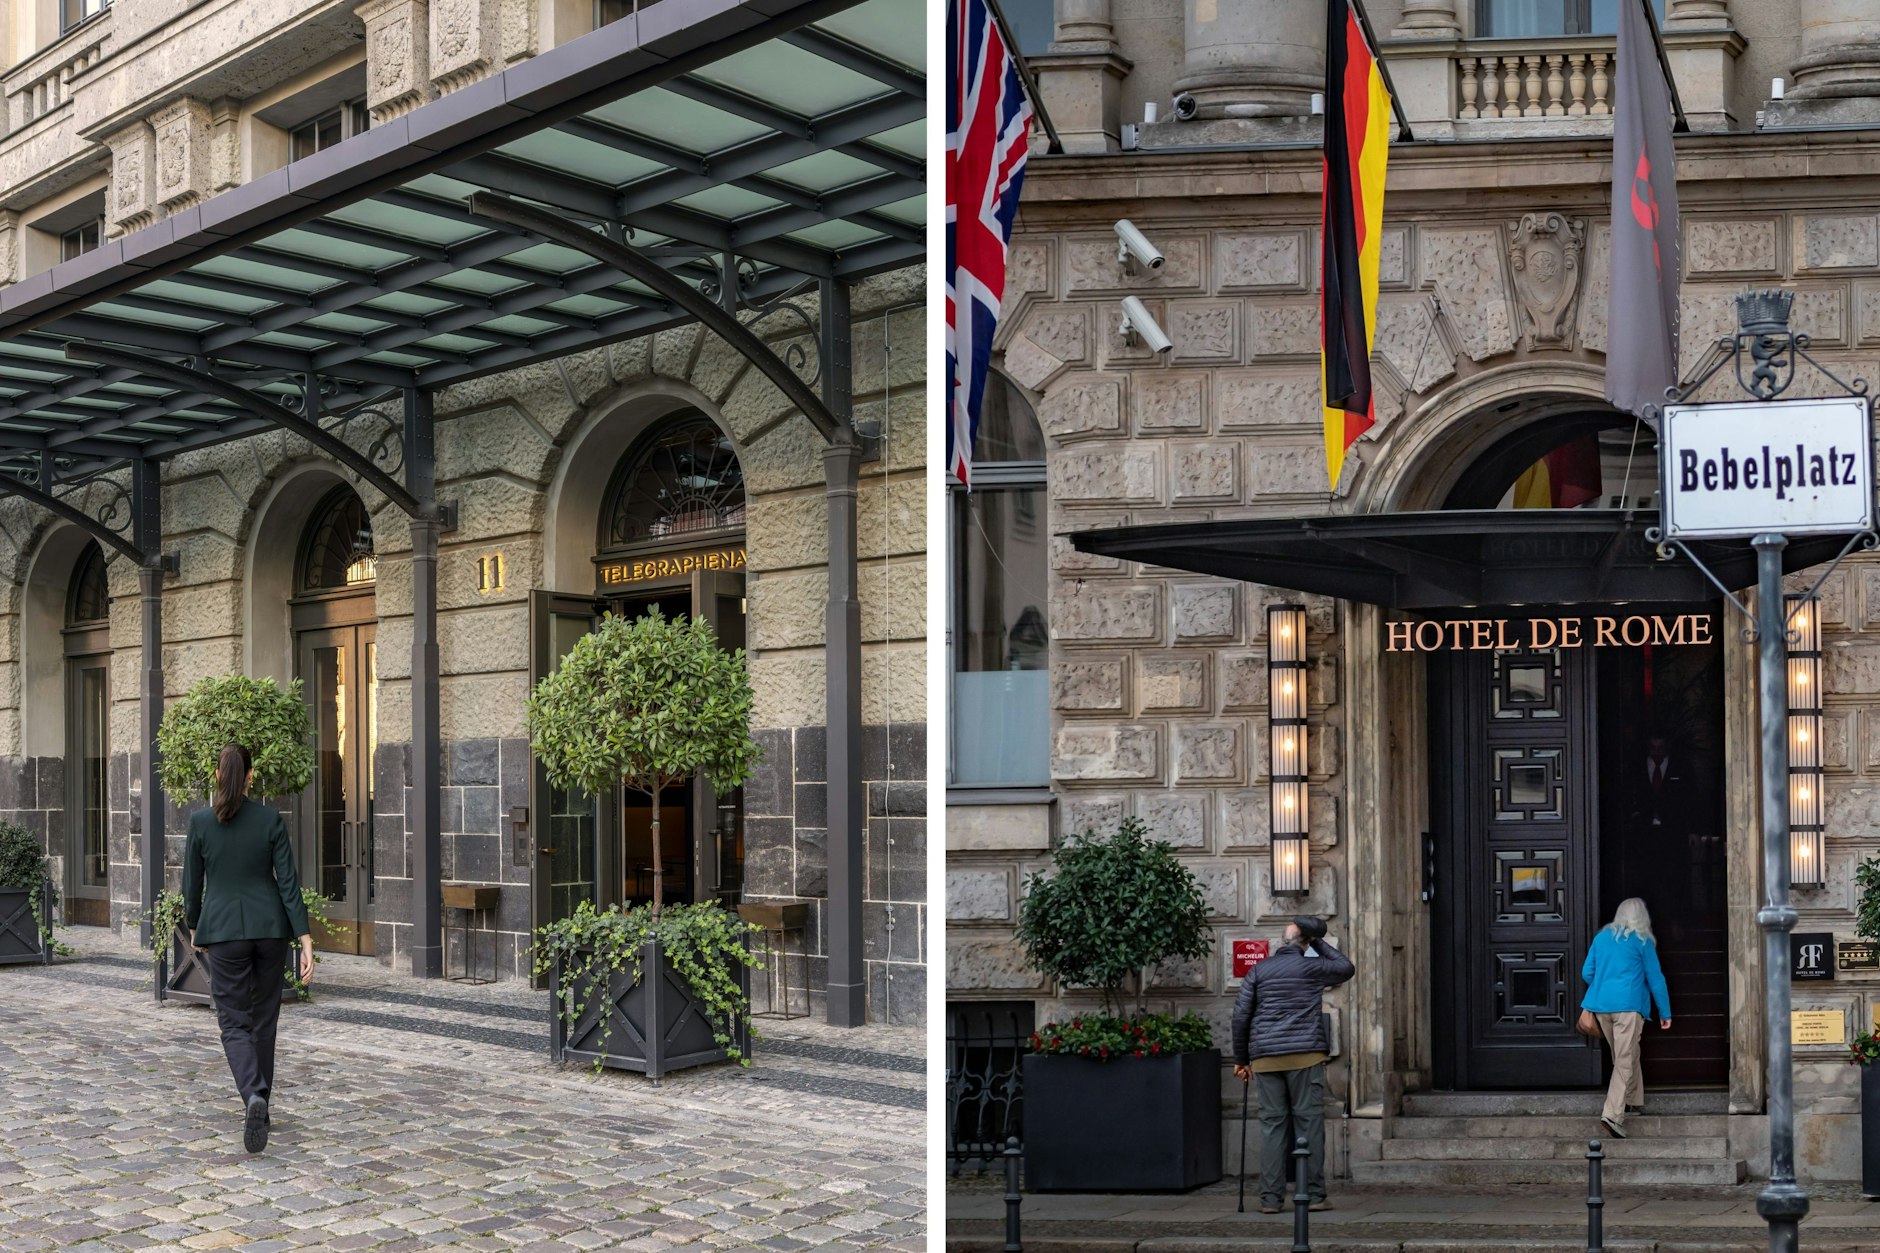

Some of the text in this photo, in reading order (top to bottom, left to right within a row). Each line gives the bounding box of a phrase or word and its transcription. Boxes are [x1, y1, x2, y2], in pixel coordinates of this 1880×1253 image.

[1679, 444, 1857, 500] Bebelplatz
[476, 555, 503, 591] 11
[1385, 614, 1714, 652] HOTEL DE ROME
